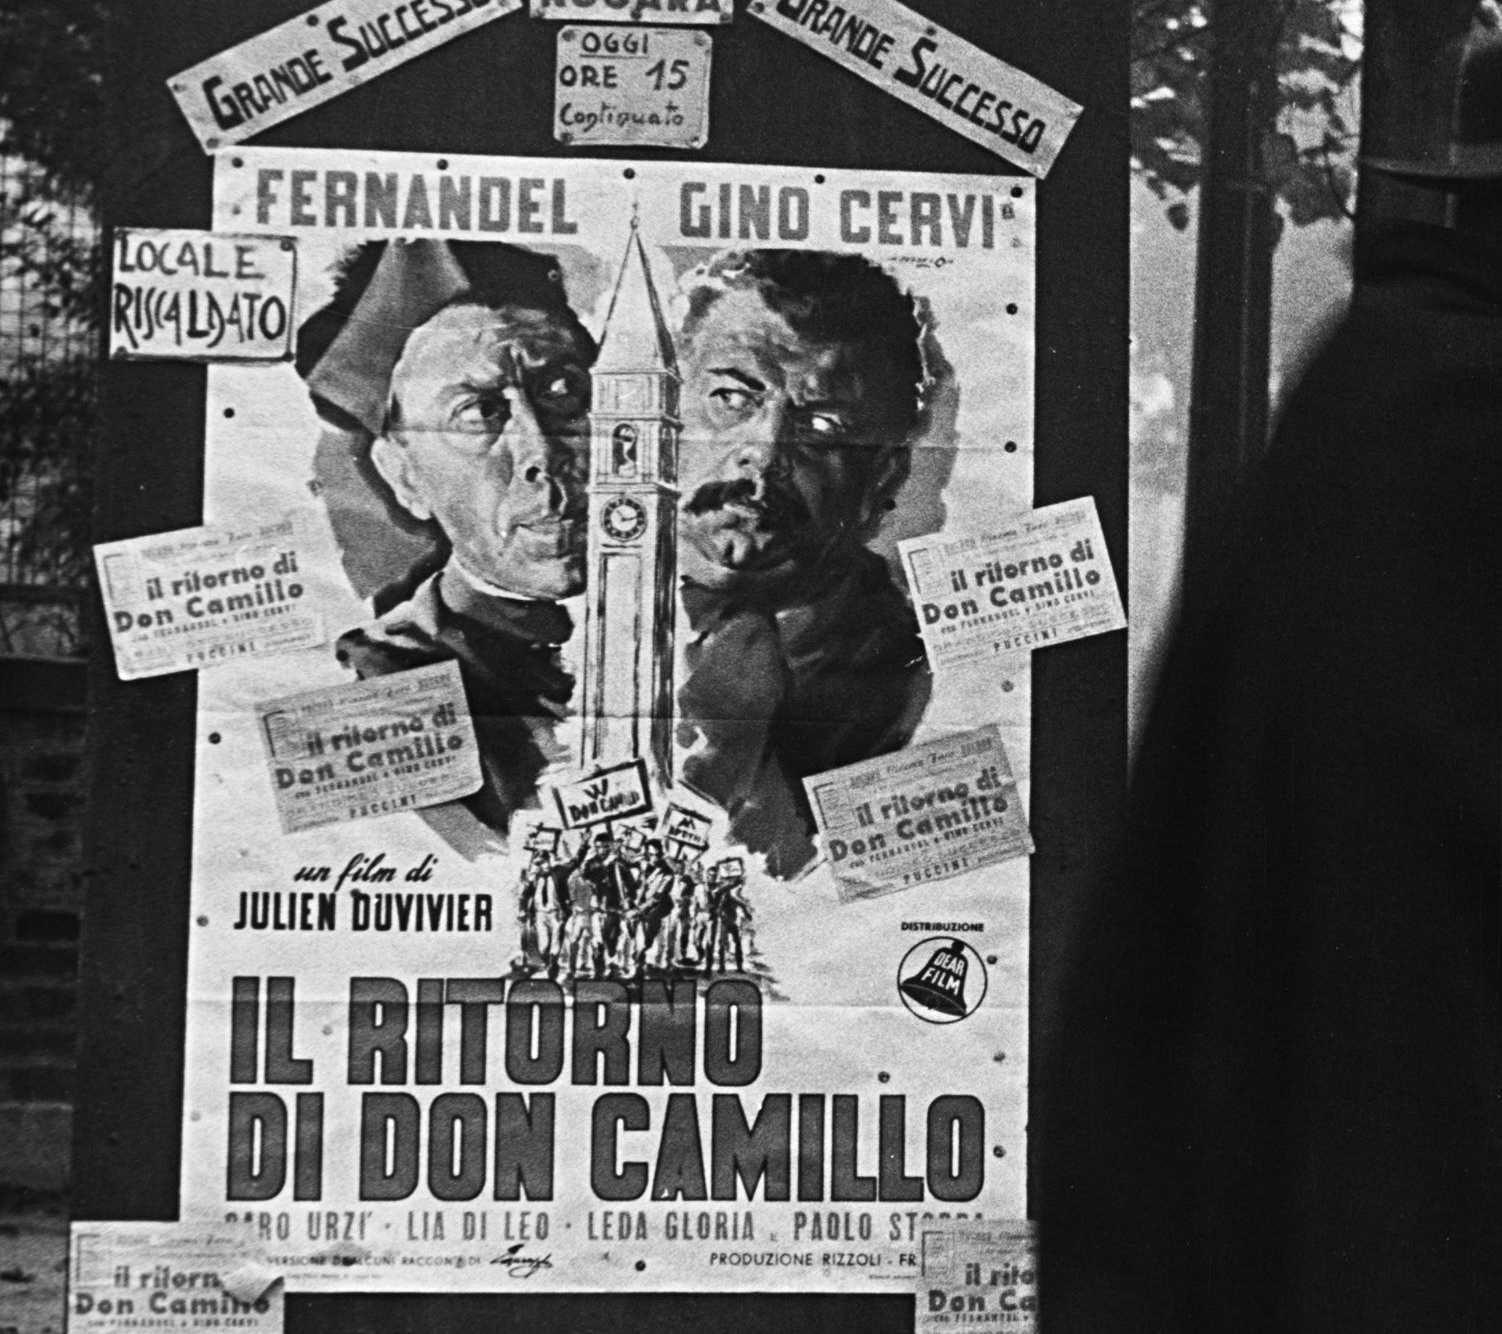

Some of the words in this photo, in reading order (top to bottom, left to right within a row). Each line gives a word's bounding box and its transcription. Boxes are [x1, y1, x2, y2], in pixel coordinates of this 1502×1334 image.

[581, 31, 650, 54] OGGI
[200, 48, 334, 131] GRANDE
[559, 64, 618, 89] ORE
[645, 58, 690, 91] 15
[893, 36, 1048, 155] SUCCESSO
[256, 169, 579, 235] FERNANDEL
[679, 181, 811, 242] GINO
[838, 188, 996, 250] CERVI
[117, 239, 268, 280] LOCALE
[112, 282, 287, 350] RISCALDATO
[146, 576, 164, 601] il
[272, 550, 299, 575] di
[950, 569, 969, 592] il
[1069, 538, 1095, 563] di
[113, 608, 174, 634] Don
[185, 578, 305, 618] Camillo
[921, 599, 979, 625] Don
[989, 567, 1101, 607] Camillo
[993, 627, 1059, 653] PUCCINI
[306, 731, 324, 757] il
[431, 701, 458, 729] di
[275, 762, 336, 789] Don
[346, 733, 463, 773] Camillo
[854, 802, 875, 828] il
[975, 765, 1003, 792] di
[828, 832, 887, 862] Don
[895, 794, 1009, 840] Camillo
[293, 866, 332, 883] un
[333, 852, 397, 893] film
[404, 853, 439, 883] di
[233, 890, 337, 931] JULIEN
[351, 892, 493, 932] DUVIVIER
[900, 921, 984, 933] DISTRIBUZIONE
[920, 967, 961, 996] FILM
[933, 951, 966, 977] DEAR
[229, 974, 314, 1086] IL
[346, 974, 765, 1088] RITORNO
[225, 1091, 326, 1203] DI
[358, 1091, 556, 1203] DON
[589, 1091, 987, 1204] CAMILLO
[406, 1210, 446, 1242] LIA
[462, 1210, 487, 1242] DI
[504, 1210, 549, 1242] LEO
[588, 1210, 649, 1242] LEDA
[665, 1210, 755, 1243] GLORIA
[793, 1210, 873, 1243] PAOLO
[139, 1265, 222, 1289] ritorn
[401, 1255, 464, 1269] RACCON
[710, 1252, 814, 1267] PRODUZIONE
[822, 1252, 882, 1267] RIZZOLI
[899, 1252, 918, 1267] FR
[965, 1262, 982, 1286] il
[75, 1291, 135, 1316] Don
[927, 1289, 986, 1313] Don
